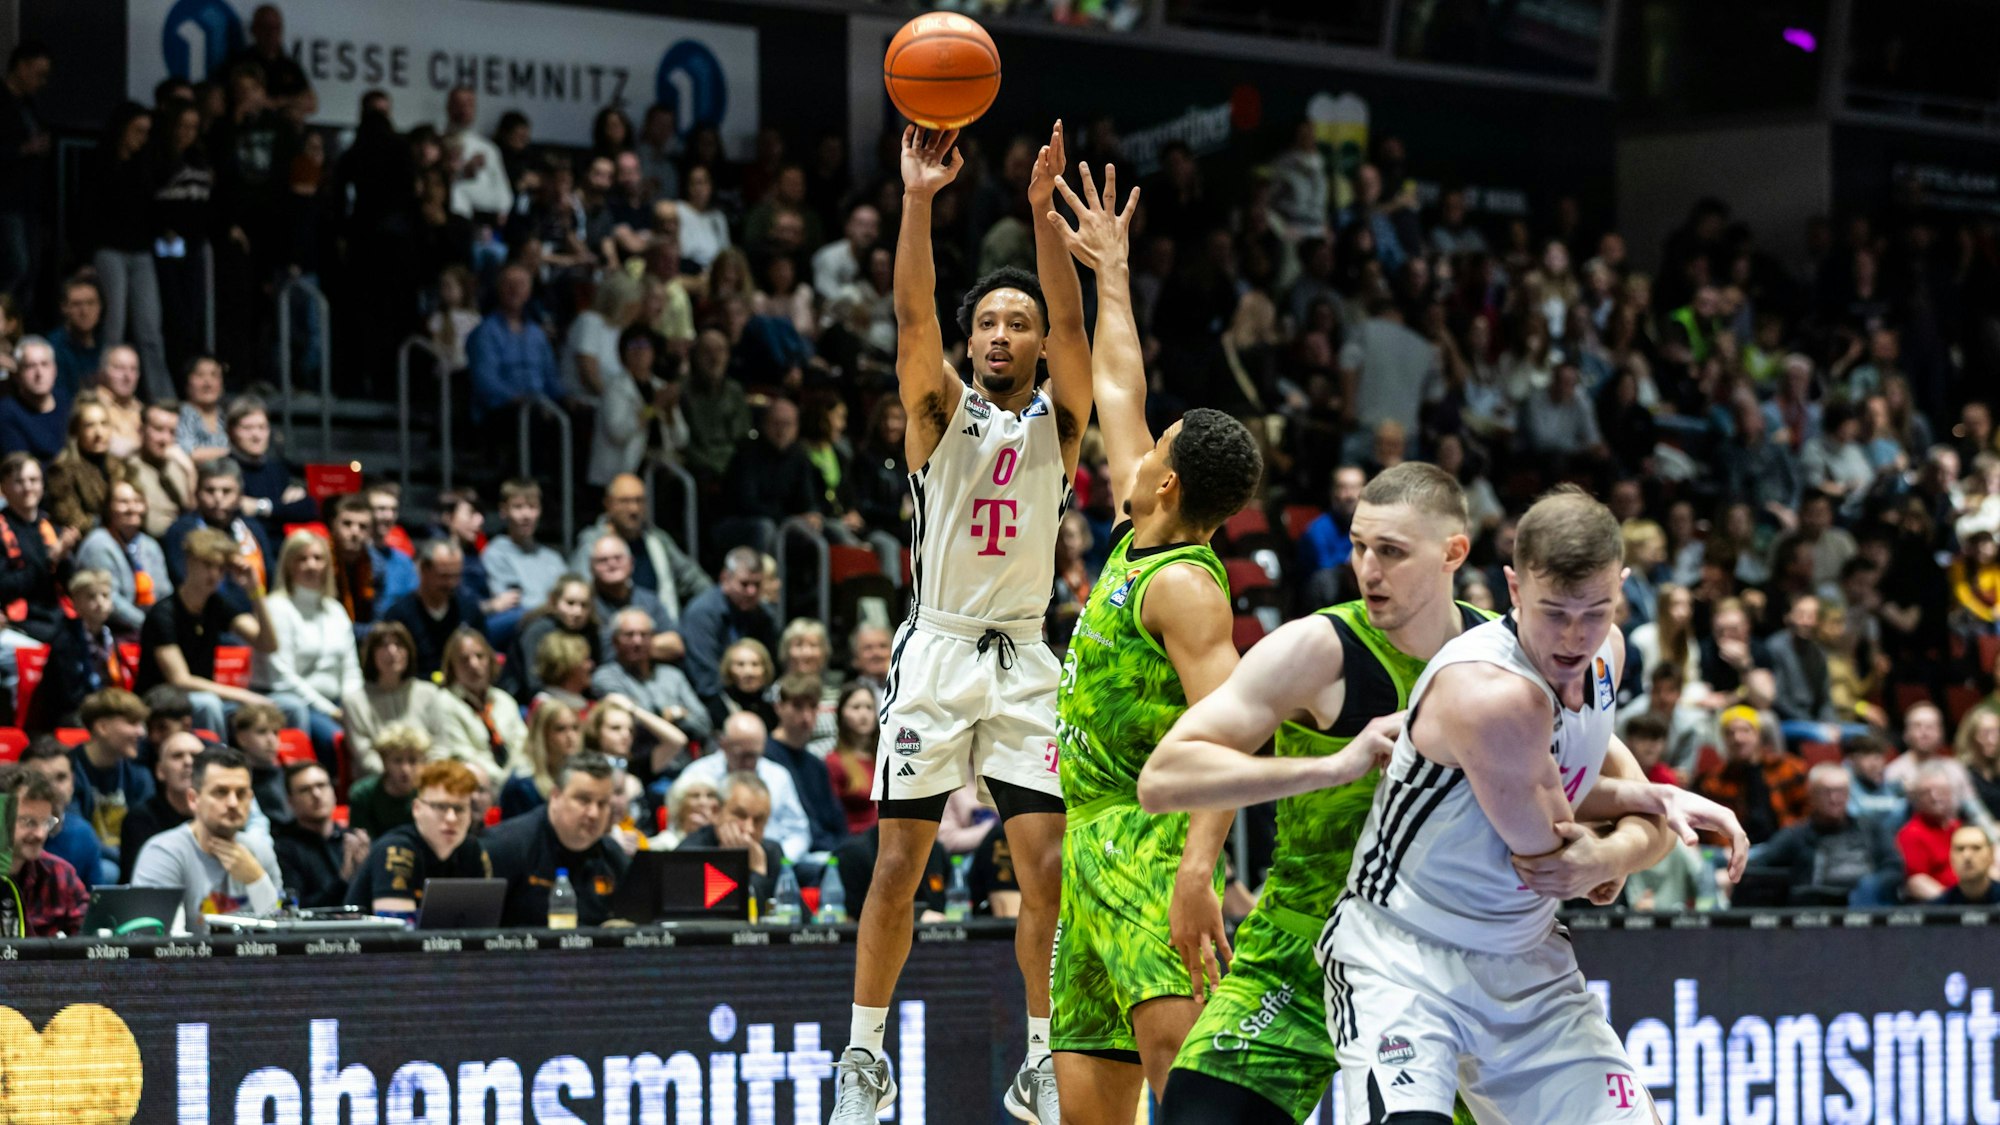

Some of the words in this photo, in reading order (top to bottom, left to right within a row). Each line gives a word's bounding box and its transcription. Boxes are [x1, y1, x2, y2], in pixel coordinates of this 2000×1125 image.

[428, 50, 631, 105] CHEMNITZ
[965, 399, 991, 418] BASKETS
[992, 447, 1018, 486] 0
[895, 742, 921, 751] BASKETS
[87, 943, 130, 960] axilaris
[1379, 1046, 1415, 1063] BASKETS
